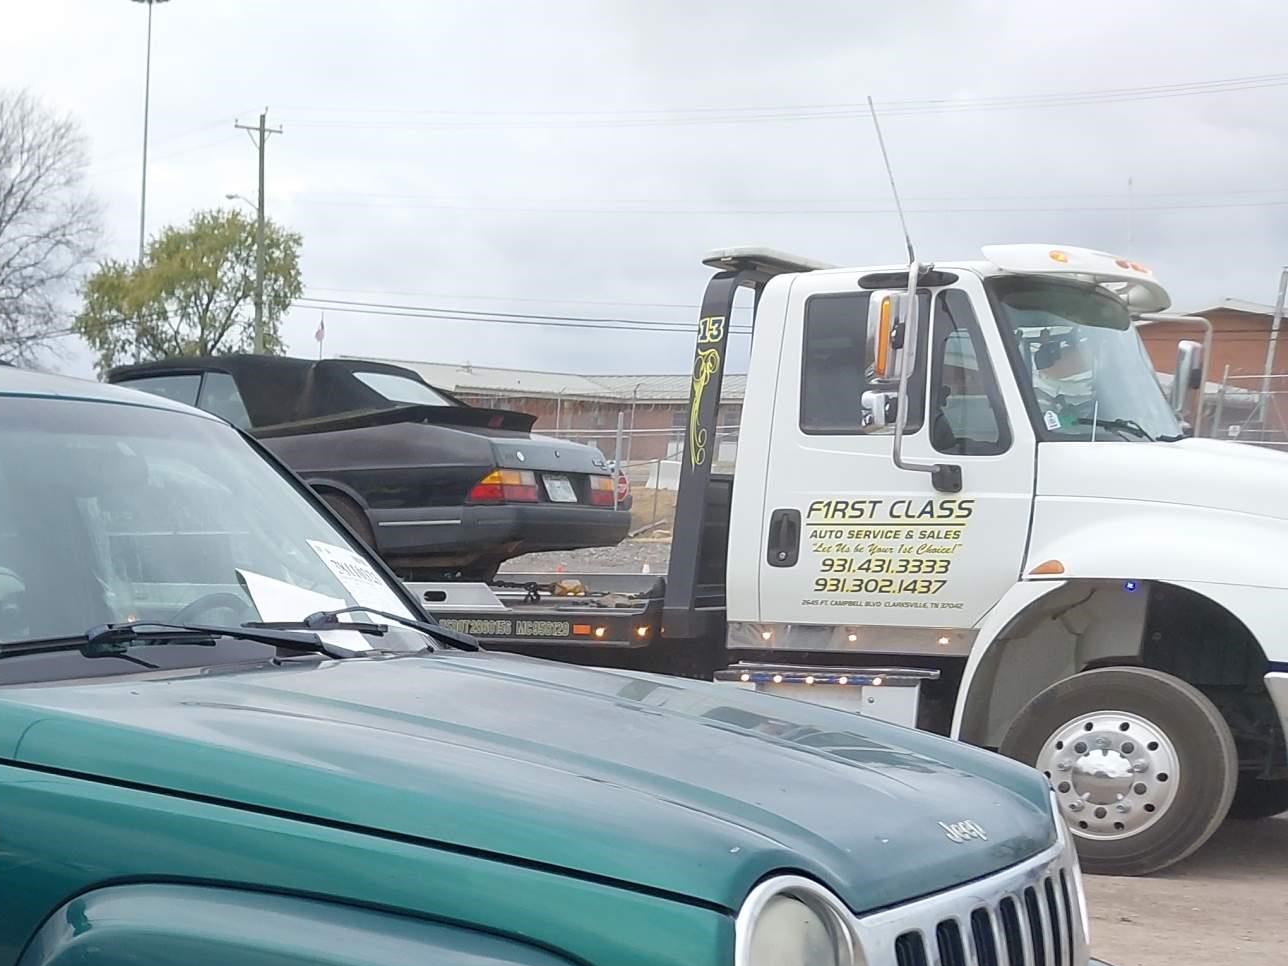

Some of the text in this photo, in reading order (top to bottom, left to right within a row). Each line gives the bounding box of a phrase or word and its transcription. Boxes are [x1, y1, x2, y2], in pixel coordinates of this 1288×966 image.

[698, 317, 725, 343] 13
[889, 500, 976, 519] CLASS
[810, 530, 961, 540] AUTO SERVICE & SALES
[835, 544, 850, 553] Us
[853, 544, 864, 553] be
[867, 544, 893, 556] Your
[820, 558, 951, 574] 931.431.3333
[814, 578, 947, 594] 931.302.1437
[938, 819, 989, 844] Jeep
